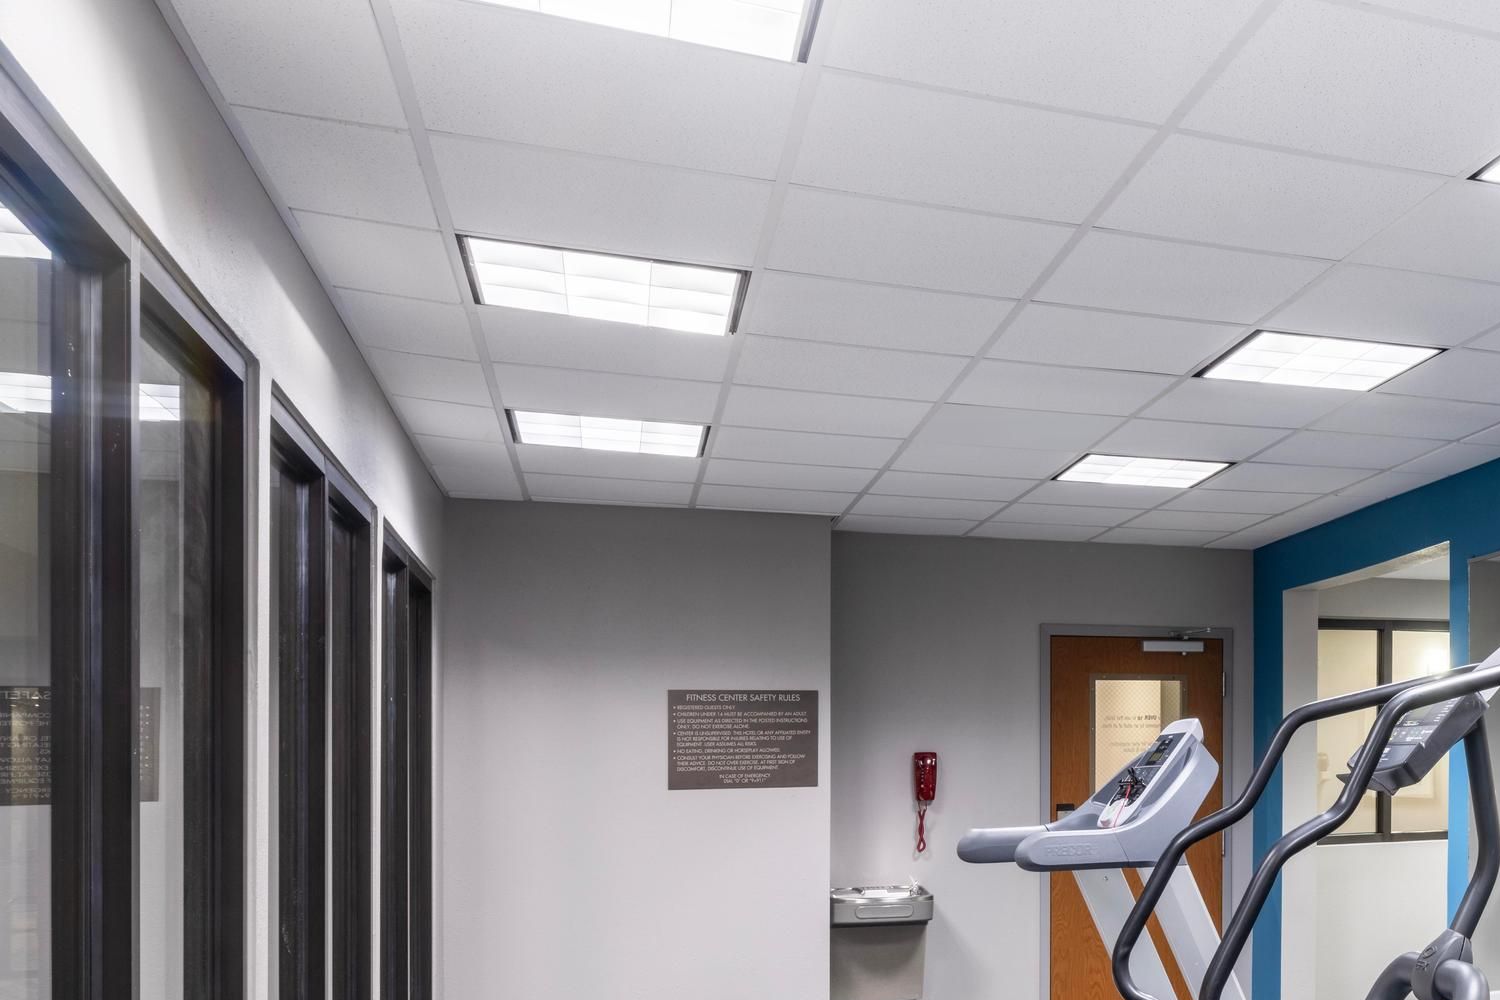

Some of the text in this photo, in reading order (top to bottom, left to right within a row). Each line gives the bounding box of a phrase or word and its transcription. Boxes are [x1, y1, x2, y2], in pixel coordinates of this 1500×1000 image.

[686, 694, 800, 702] FITNESS CENTER SAFETY RULES
